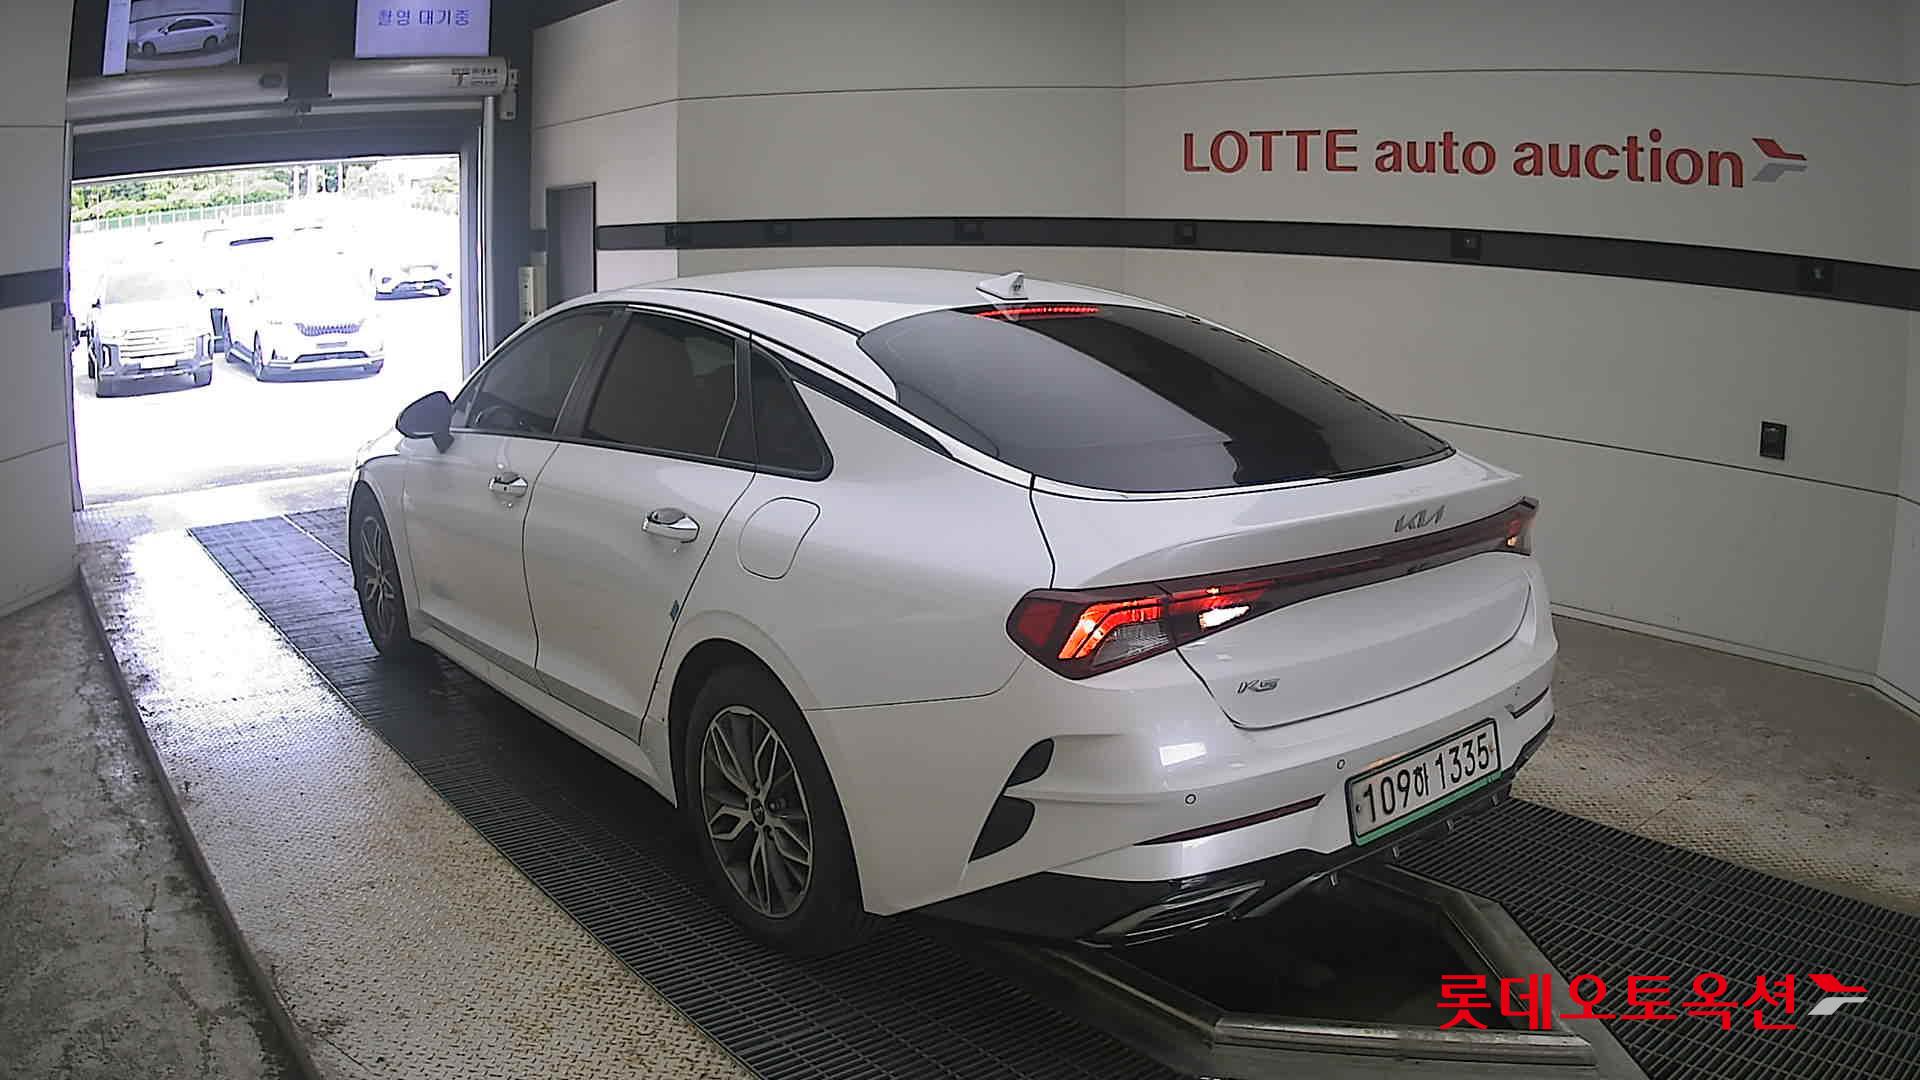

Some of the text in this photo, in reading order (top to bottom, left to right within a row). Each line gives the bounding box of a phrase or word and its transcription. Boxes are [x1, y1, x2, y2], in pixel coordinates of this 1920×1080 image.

[419, 8, 470, 26] 대기중
[1183, 128, 1744, 188] LOTTE auto auction
[1363, 732, 1490, 823] 109하 1335
